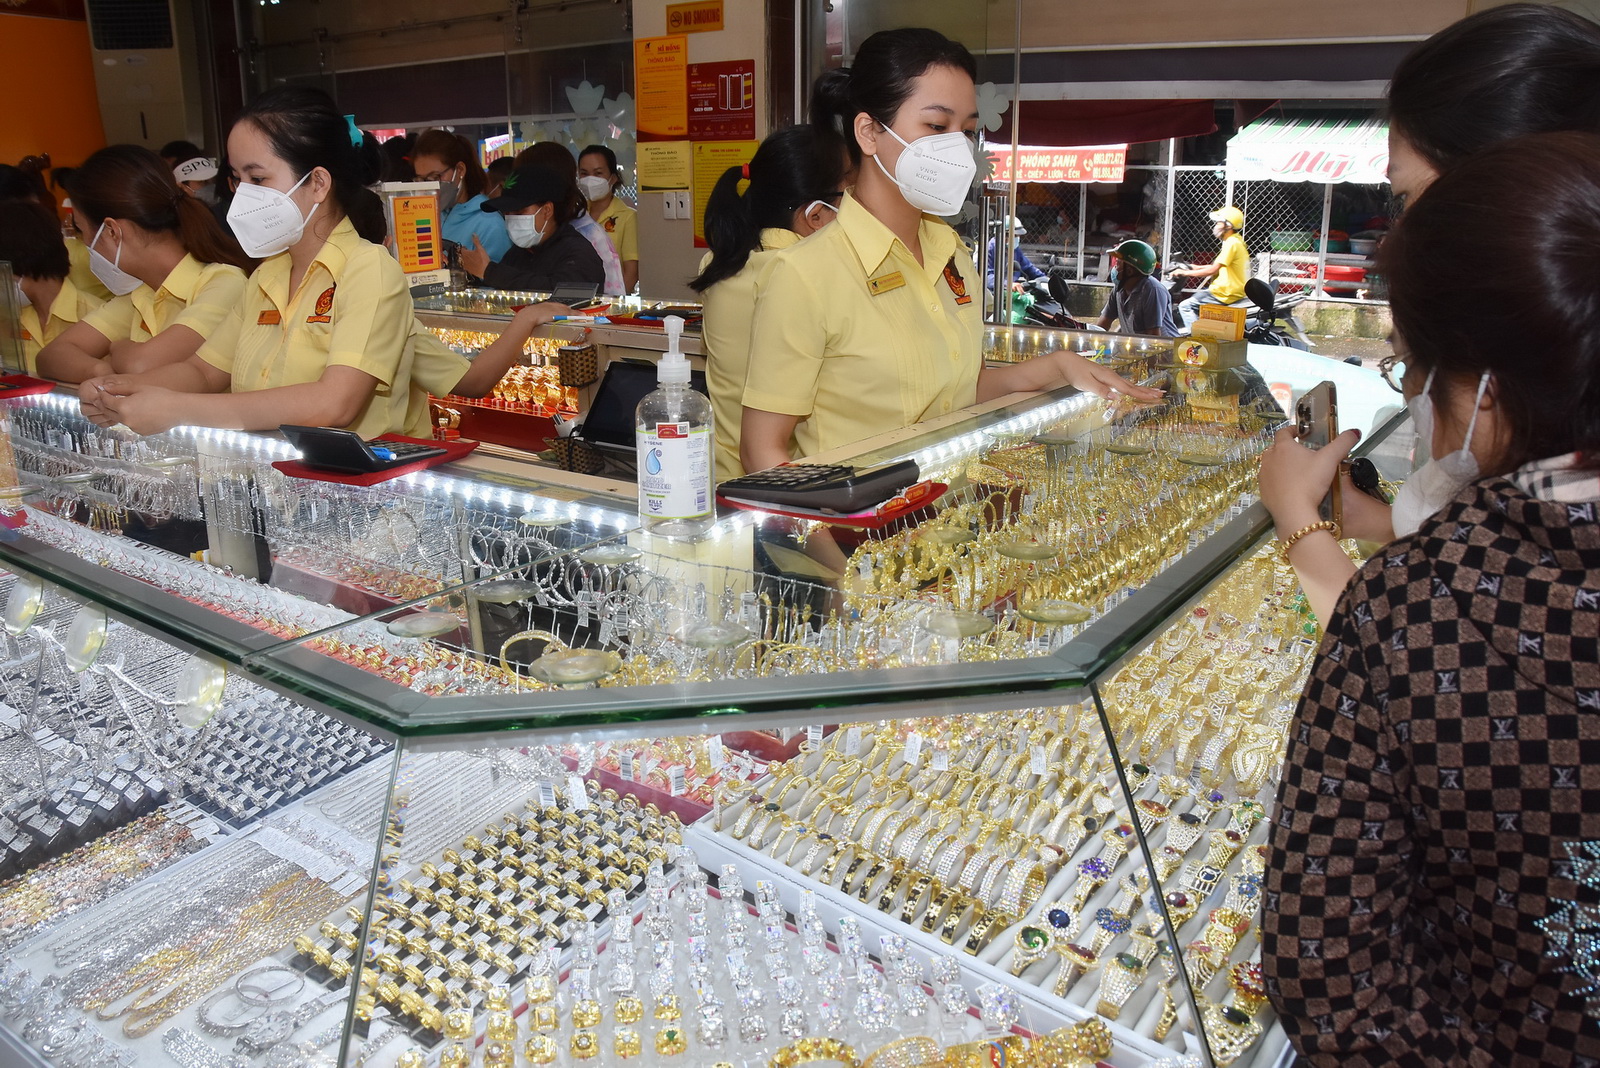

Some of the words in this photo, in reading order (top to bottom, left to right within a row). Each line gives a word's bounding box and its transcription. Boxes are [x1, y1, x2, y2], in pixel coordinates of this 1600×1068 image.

[684, 10, 692, 26] NO
[694, 8, 720, 24] SMOKING
[1020, 152, 1050, 167] PHÓNG
[1052, 155, 1078, 167] SANH
